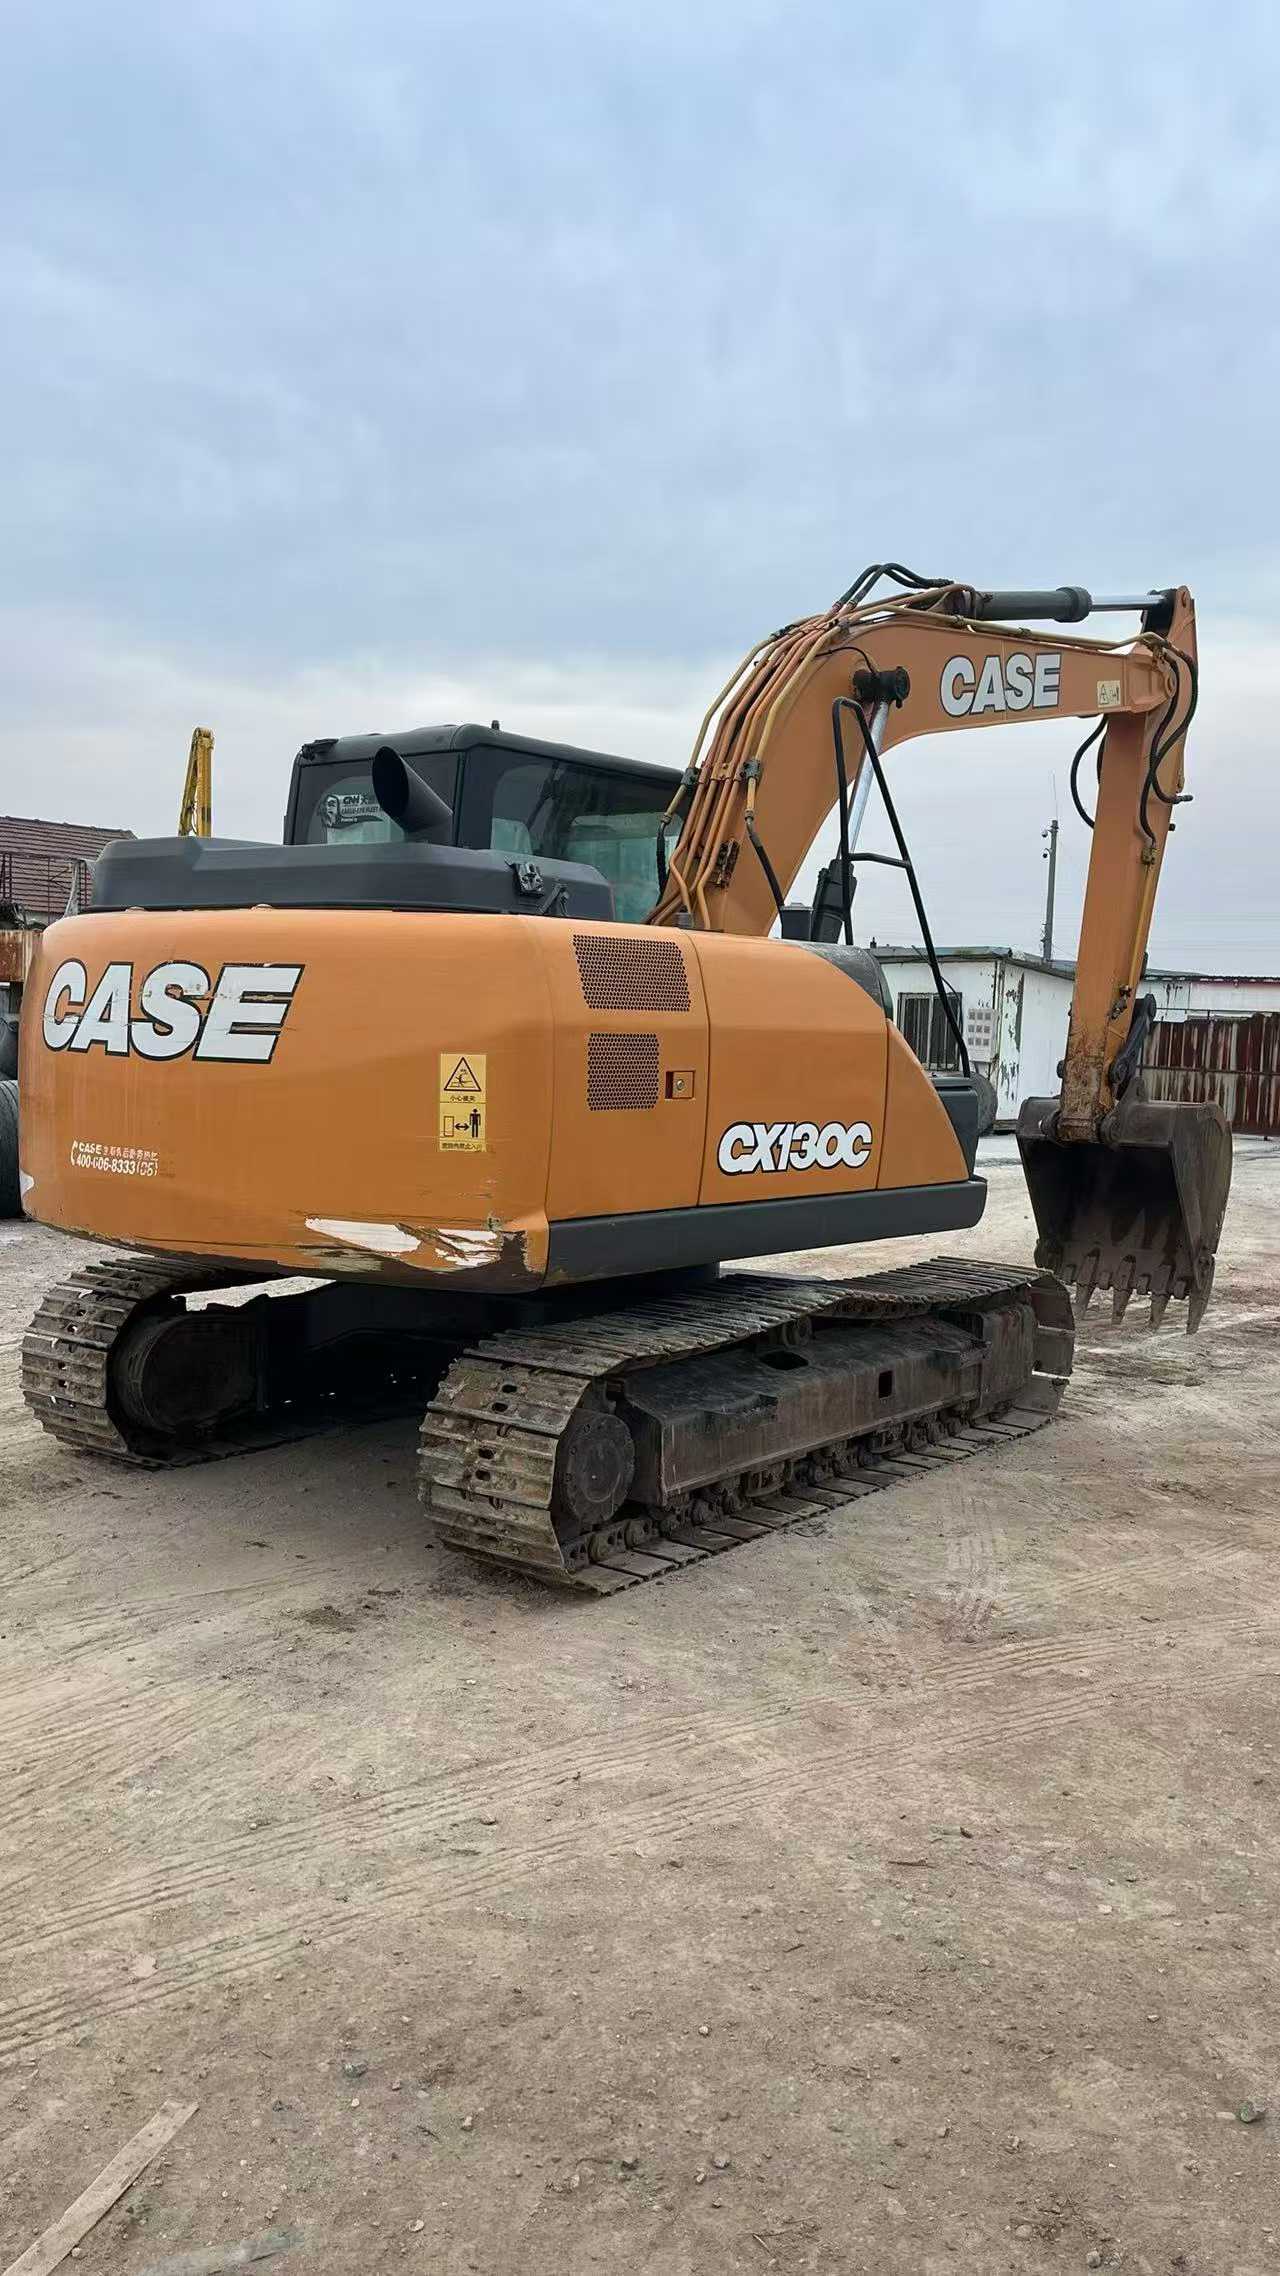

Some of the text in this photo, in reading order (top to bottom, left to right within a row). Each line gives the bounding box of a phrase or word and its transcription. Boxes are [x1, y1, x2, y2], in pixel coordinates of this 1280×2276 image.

[940, 652, 1062, 717] CASE
[43, 957, 305, 1064] CASE
[78, 1142, 102, 1155] CASE
[717, 1121, 873, 1176] CX130C
